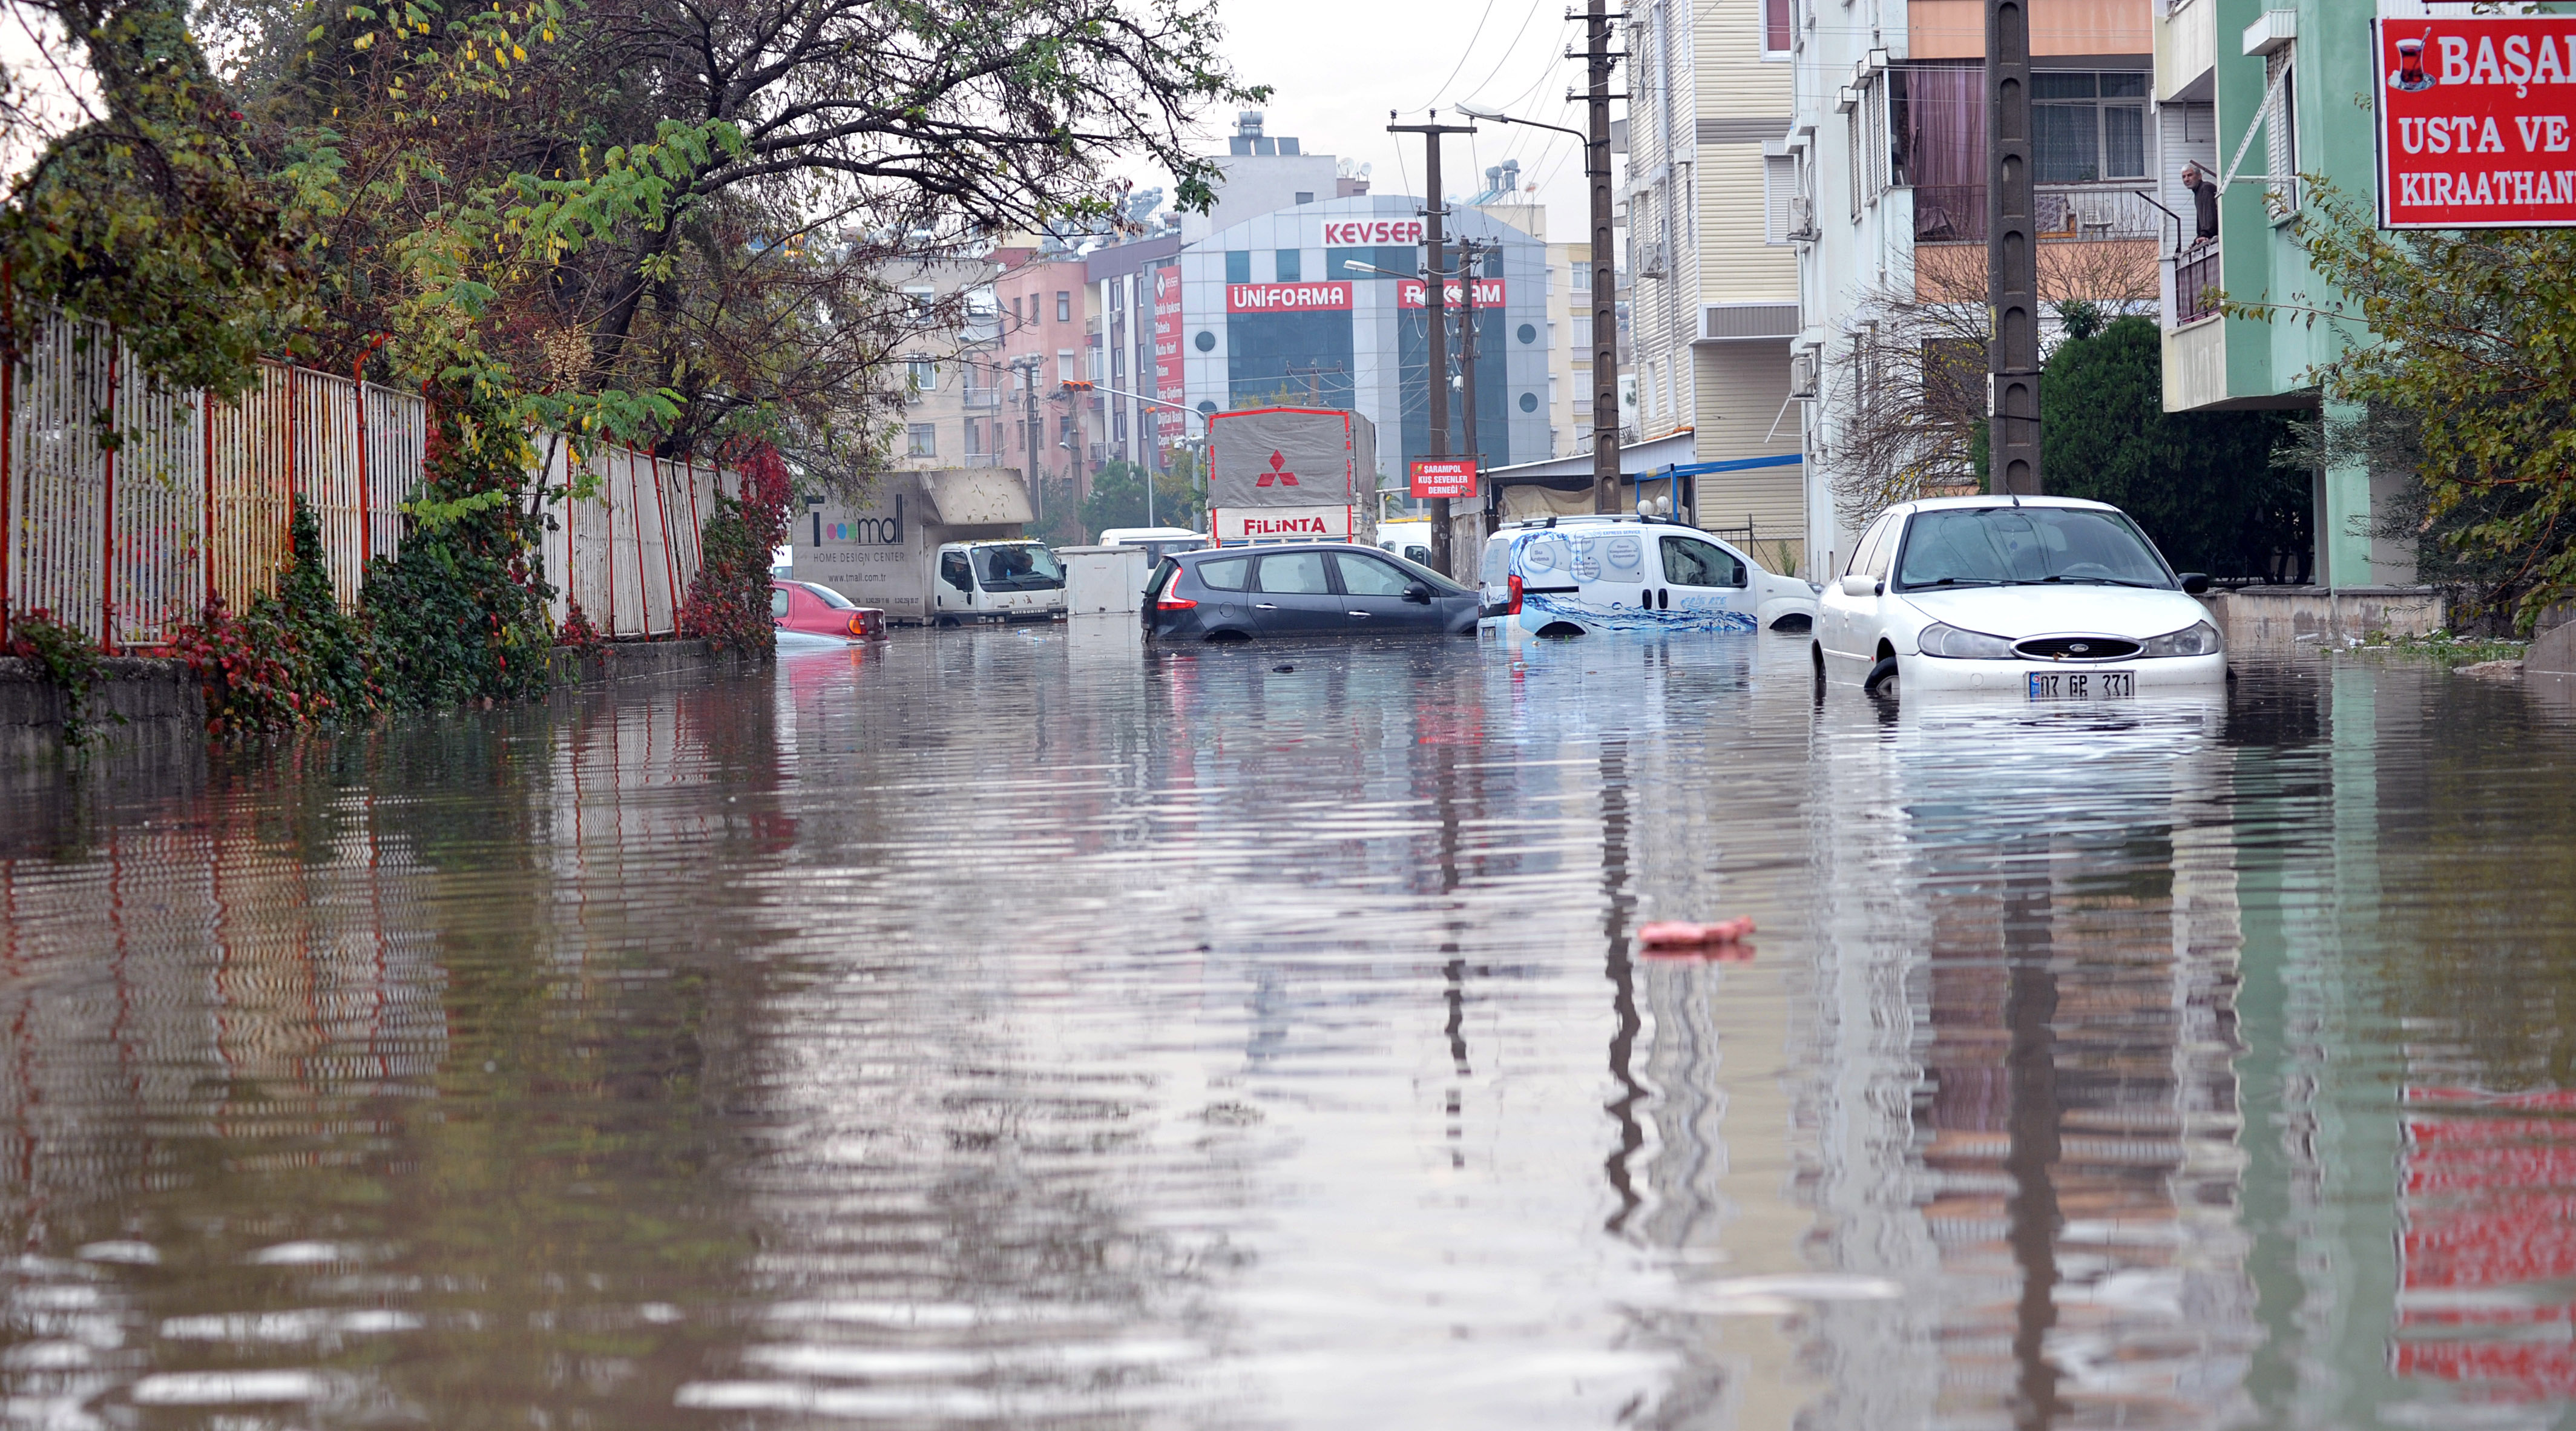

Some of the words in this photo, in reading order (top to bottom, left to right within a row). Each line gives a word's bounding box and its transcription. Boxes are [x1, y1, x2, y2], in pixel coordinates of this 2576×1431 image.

[2399, 116, 2505, 154] USTA
[2514, 116, 2570, 152] VE
[2399, 171, 2576, 206] KIRAATHAN
[1326, 222, 1422, 244] KEVSER
[1155, 321, 1170, 334] Tabela
[1156, 343, 1166, 356] Kutu
[1167, 341, 1176, 354] Harf
[1424, 465, 1462, 474] ŞARAMPOL
[1418, 476, 1432, 484] KUŞ
[1434, 475, 1468, 484] SEVENLER
[1428, 485, 1458, 494] DERNEĞİ
[813, 553, 836, 562] HOME
[840, 552, 870, 562] DESIGN
[873, 551, 904, 562] CENTER
[828, 573, 886, 582] www.tmall.com.tr
